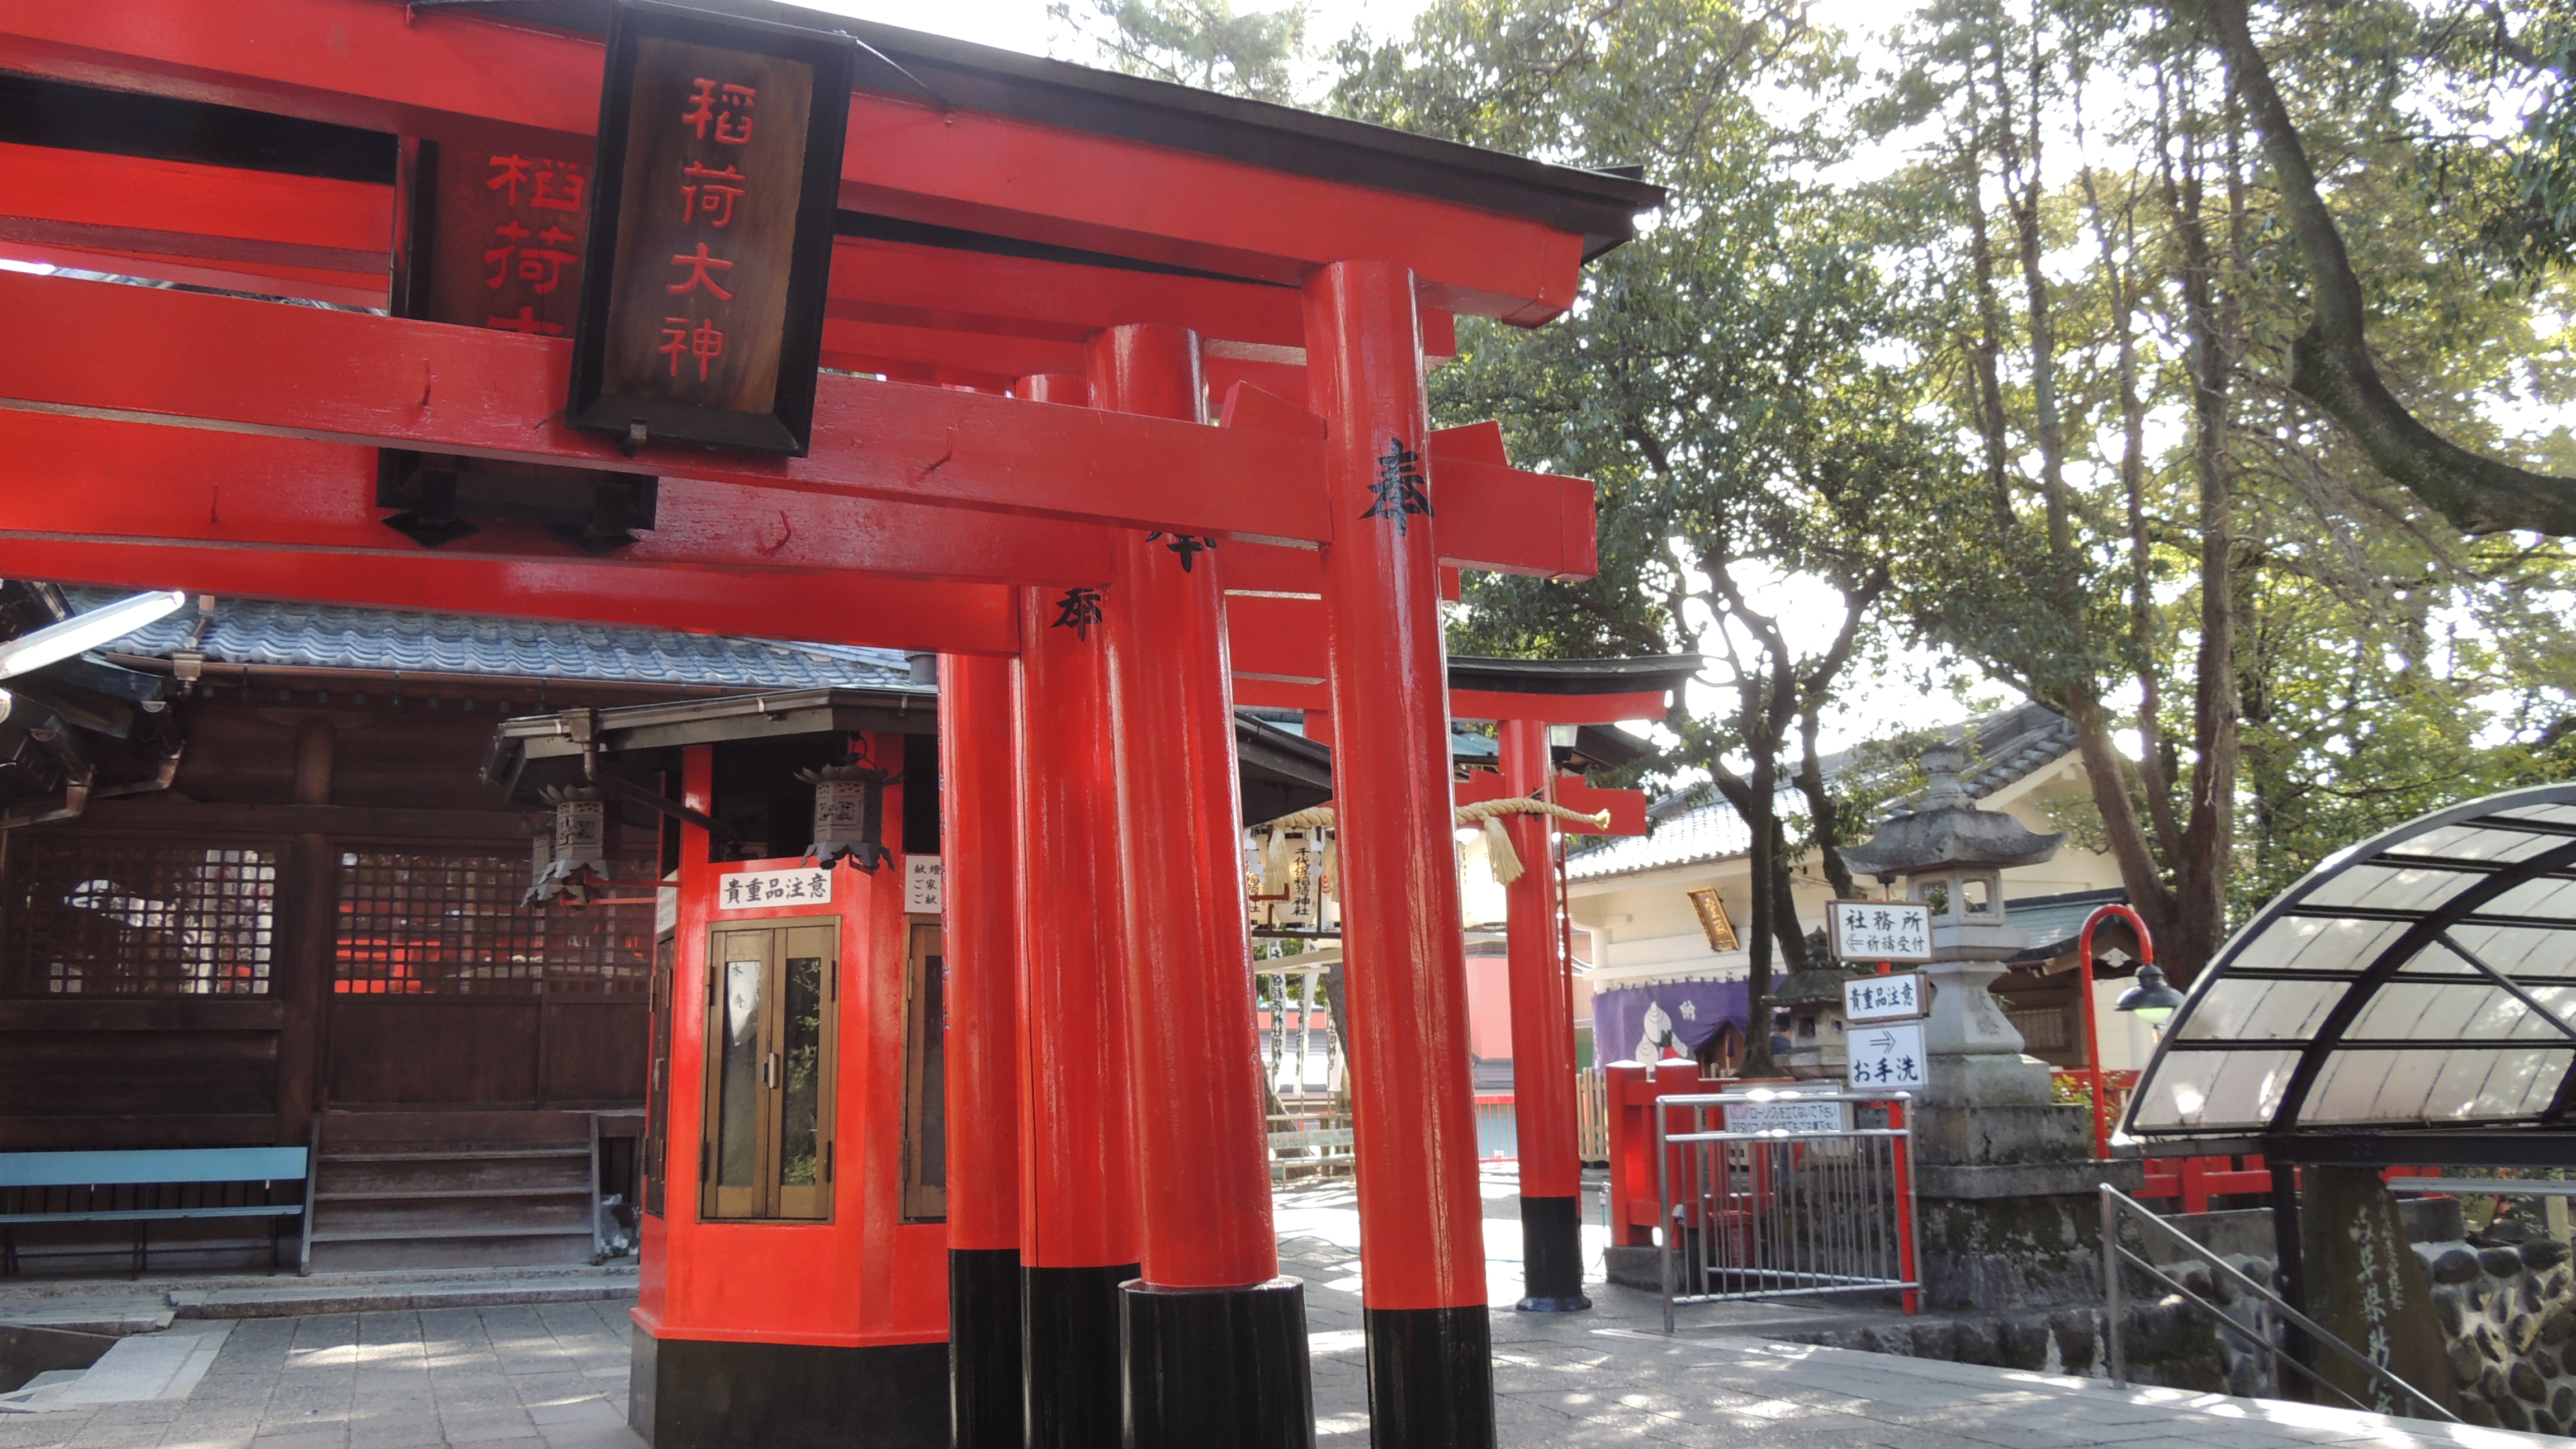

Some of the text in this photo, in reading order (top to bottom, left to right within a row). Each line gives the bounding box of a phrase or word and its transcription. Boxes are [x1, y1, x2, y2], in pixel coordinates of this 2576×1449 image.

[1358, 437, 1436, 538] 奉
[723, 872, 828, 905] 貴重品注意
[1291, 847, 1311, 917] 千代保稲荷神社
[1845, 908, 1924, 933] 社務所
[1678, 999, 1697, 1021] 納
[1849, 981, 1914, 1012] 貴重品注意
[1853, 1054, 1919, 1083] お手洗
